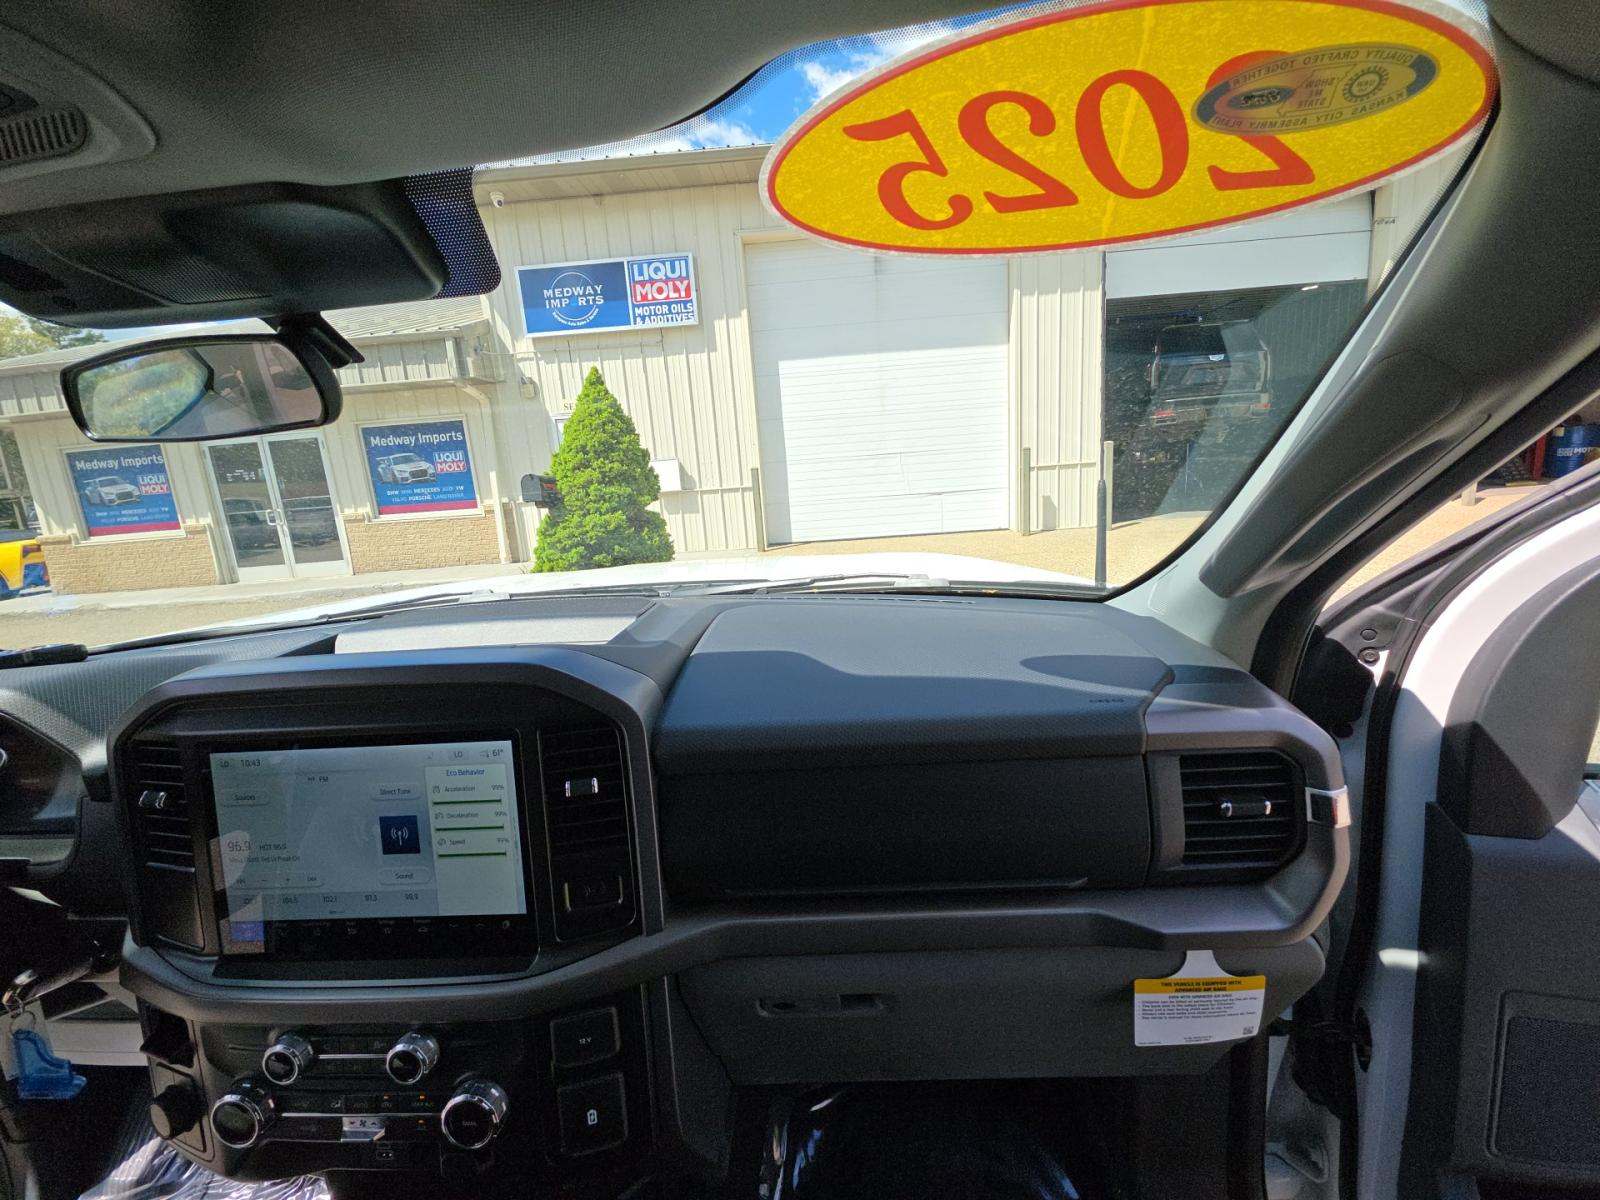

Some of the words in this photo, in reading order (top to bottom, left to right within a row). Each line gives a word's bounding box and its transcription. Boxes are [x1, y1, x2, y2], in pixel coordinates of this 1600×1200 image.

[633, 260, 688, 281] LIQUI
[543, 284, 603, 298] MEDWAY
[635, 279, 690, 301] MOLY
[545, 295, 605, 309] IMPRTS
[635, 305, 669, 317] MOTOR
[672, 302, 693, 313] OILS
[643, 312, 695, 326] ADDITIVES
[370, 434, 416, 447] Medway
[418, 431, 463, 444] Imports
[75, 458, 119, 471] Medway
[120, 454, 164, 468] Imports
[435, 452, 463, 461] LIQUI
[437, 462, 466, 472] MOLY
[139, 475, 166, 485] LIQUI
[141, 484, 168, 494] MOLY
[240, 758, 261, 768] 10:43
[446, 769, 461, 777] Eco
[461, 768, 485, 777] Behavior
[227, 840, 251, 853] 96.9
